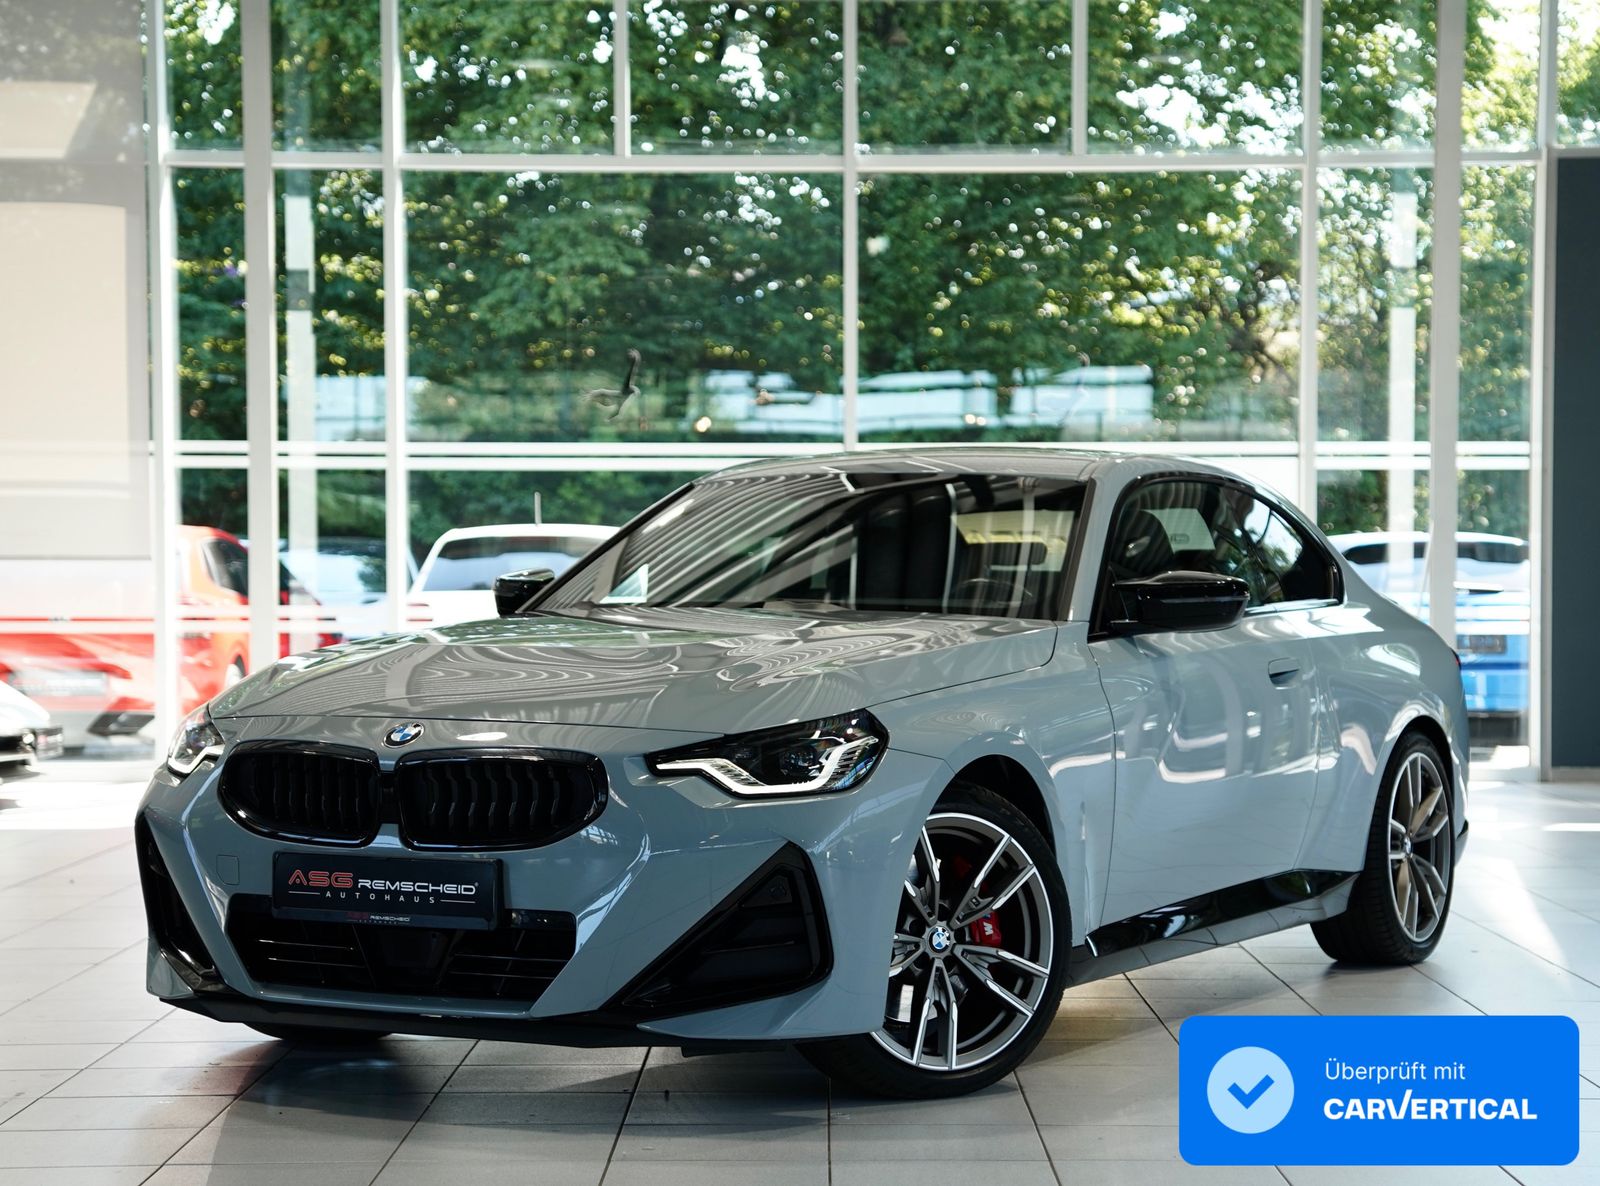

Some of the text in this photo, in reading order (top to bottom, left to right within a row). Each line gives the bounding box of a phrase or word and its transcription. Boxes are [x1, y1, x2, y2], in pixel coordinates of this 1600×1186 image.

[288, 869, 476, 895] ASG REMSCHEID
[325, 890, 435, 904] AUTOHAUS
